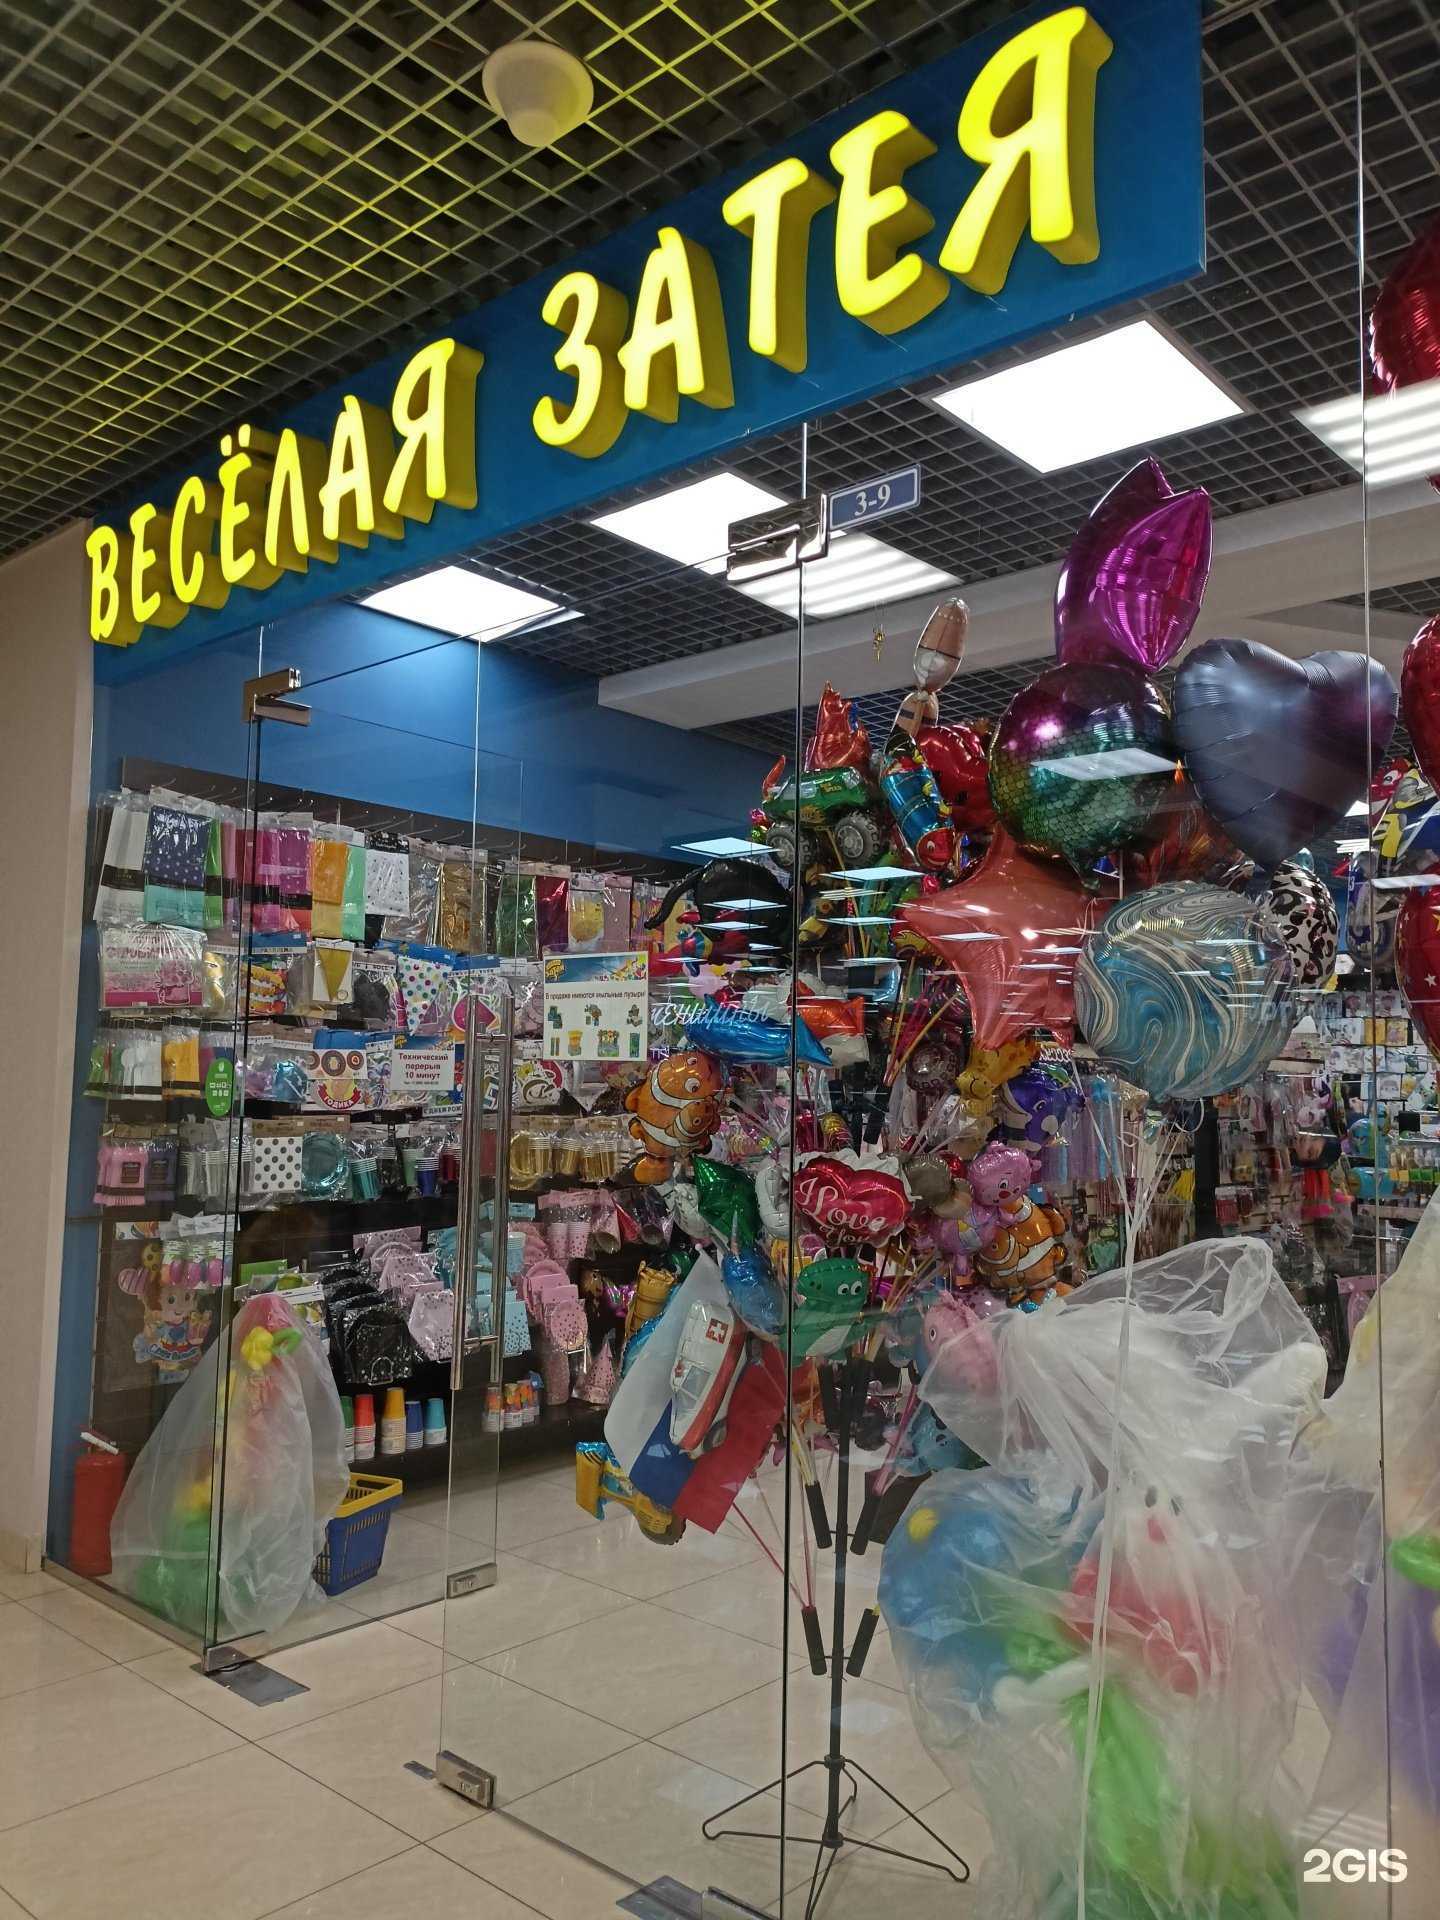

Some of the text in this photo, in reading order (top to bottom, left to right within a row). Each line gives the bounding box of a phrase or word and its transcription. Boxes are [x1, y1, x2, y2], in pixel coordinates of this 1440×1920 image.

[86, 6, 1100, 643] ВЕСЁЛАЯ ЗАТЕЯ
[854, 484, 891, 516] 3-9
[550, 992, 571, 1001] продаже
[399, 1053, 448, 1061] Технический
[323, 1095, 354, 1109] ГОДИКА
[802, 1185, 888, 1231] Love
